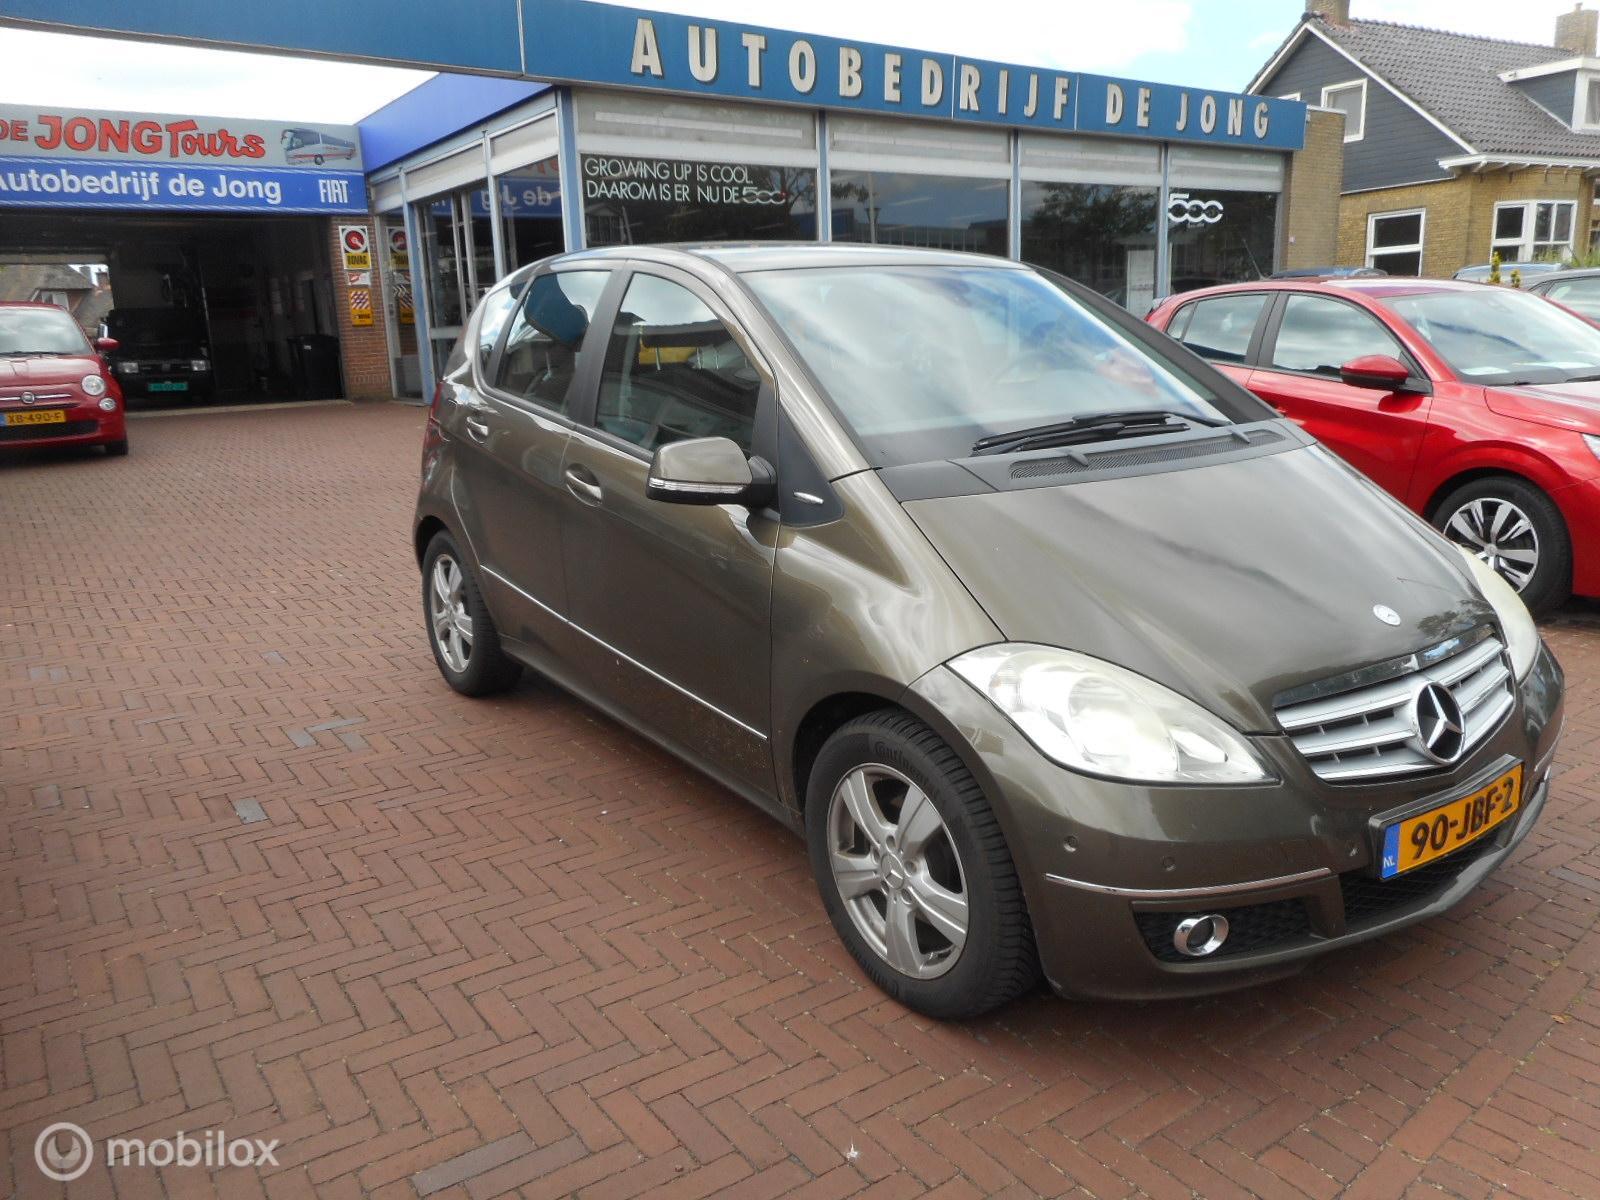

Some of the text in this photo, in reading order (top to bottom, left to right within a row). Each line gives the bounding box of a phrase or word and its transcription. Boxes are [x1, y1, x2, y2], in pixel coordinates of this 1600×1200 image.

[630, 17, 1269, 139] AUTOBEDRIJF DE JONG
[34, 114, 163, 154] JONG
[165, 119, 266, 158] Tours
[584, 157, 753, 185] GROWING UP IS COOL
[168, 173, 205, 197] de
[212, 175, 282, 204] Jong
[318, 179, 349, 203] FIAT
[586, 180, 657, 201] DAAROM
[659, 183, 671, 201] IS
[673, 184, 690, 202] ER
[697, 185, 719, 203] NU
[722, 187, 740, 205] DE
[1167, 192, 1224, 224] 500
[1411, 776, 1515, 861] 90-JBF-2
[1383, 855, 1396, 869] NL
